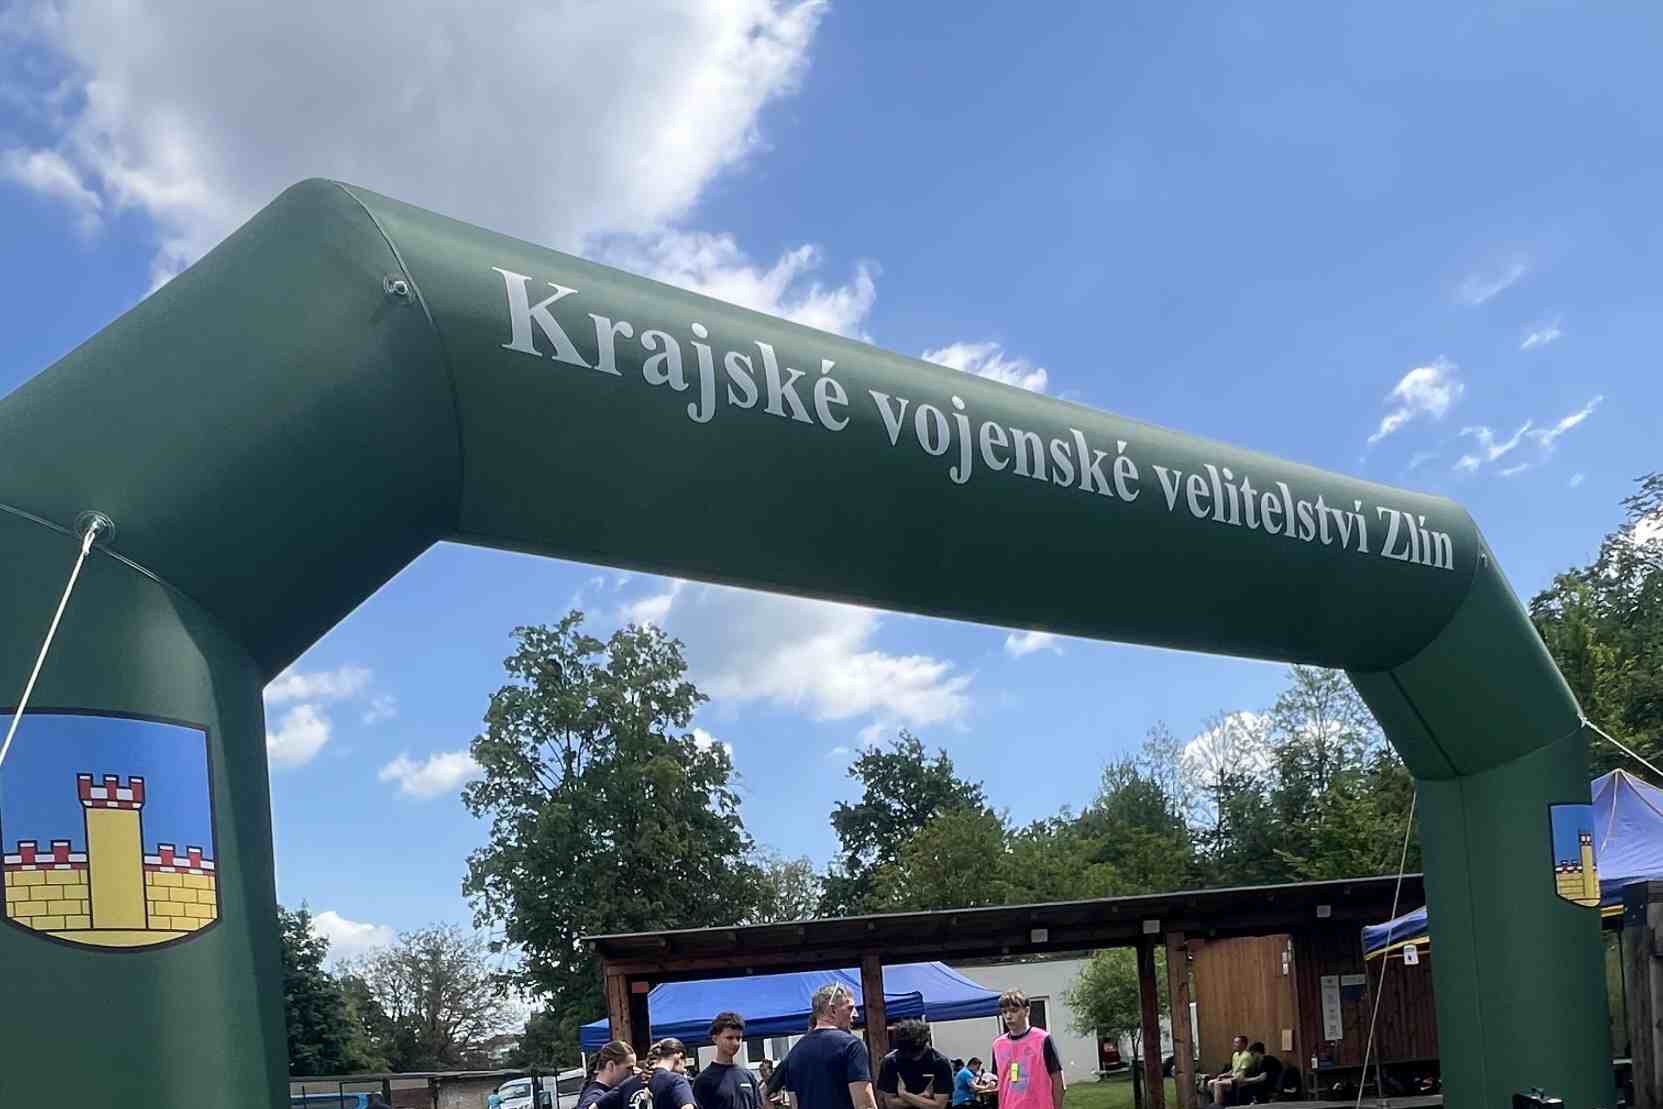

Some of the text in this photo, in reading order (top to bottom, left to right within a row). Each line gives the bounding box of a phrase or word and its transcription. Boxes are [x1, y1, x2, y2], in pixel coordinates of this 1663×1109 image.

[492, 266, 1455, 570] Krajské vojenské velitelství Zlín
